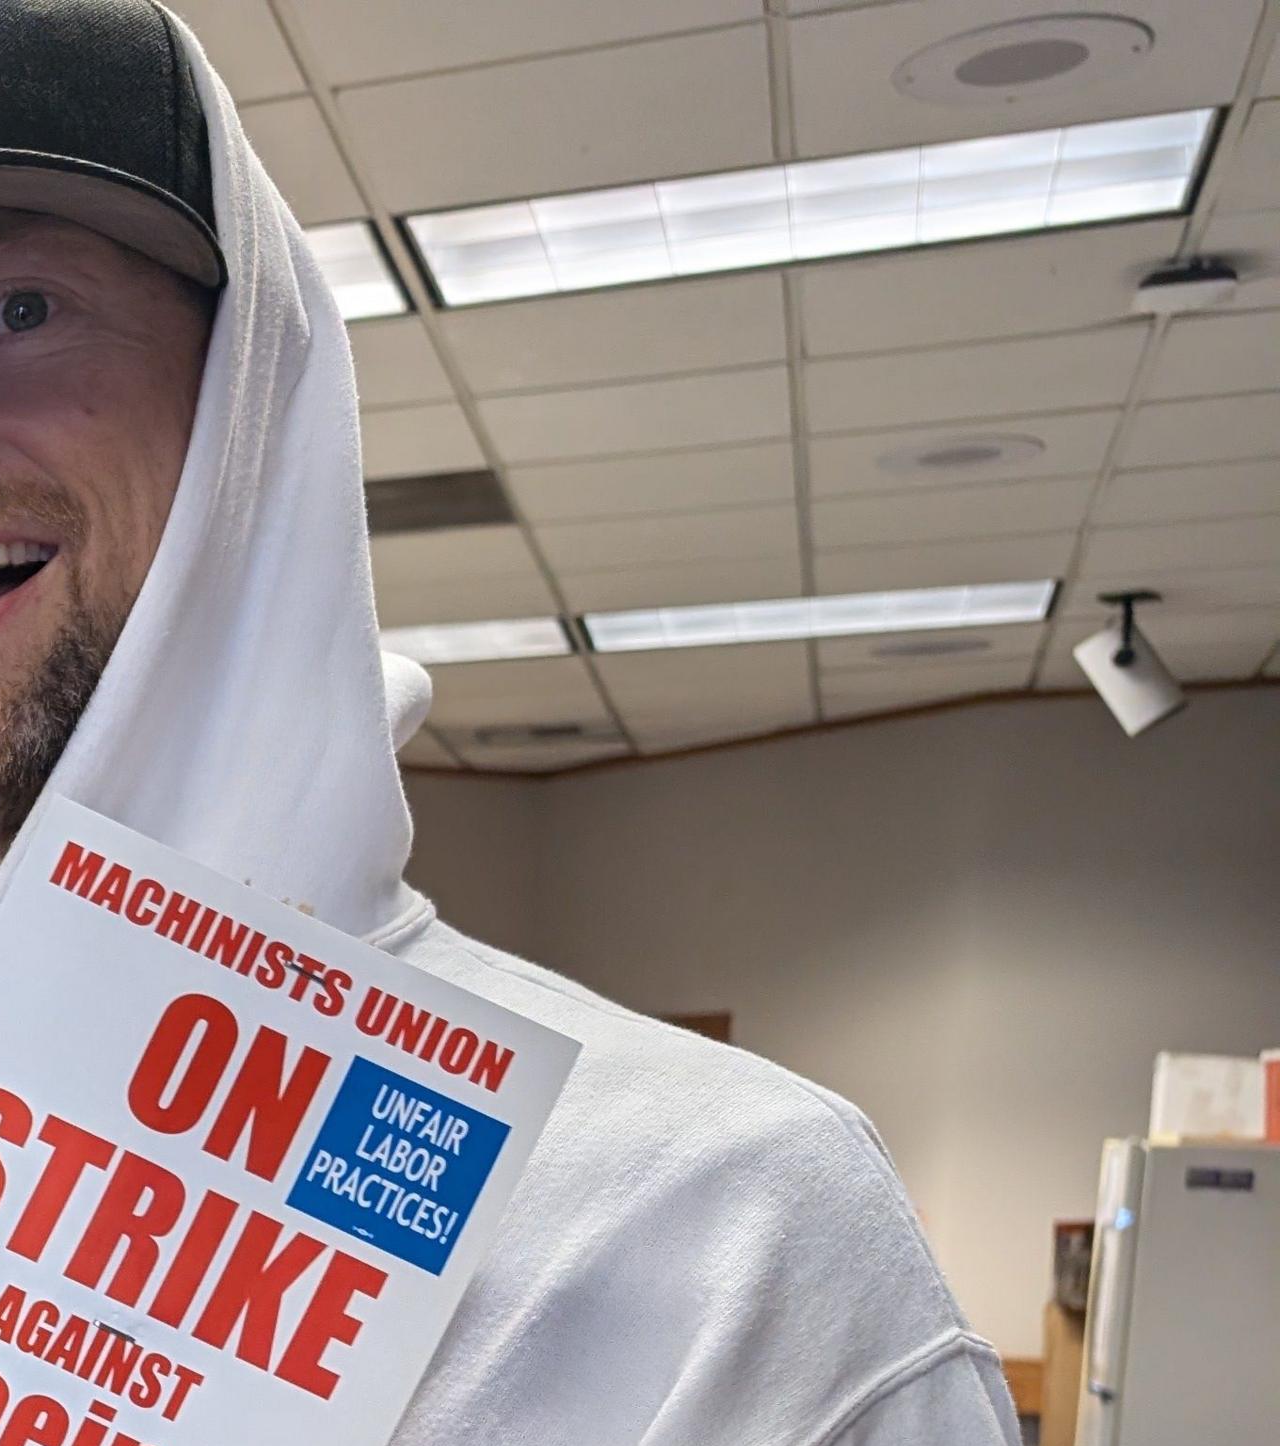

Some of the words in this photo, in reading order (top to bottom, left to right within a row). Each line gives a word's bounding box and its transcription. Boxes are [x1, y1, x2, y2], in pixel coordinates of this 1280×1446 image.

[49, 840, 353, 1017] MACHINISTS
[354, 985, 516, 1093] UNION
[127, 993, 332, 1183] ON
[371, 1084, 469, 1156] UNFAIR
[305, 1149, 460, 1244] PRACTICES!
[355, 1124, 447, 1192] LABOR
